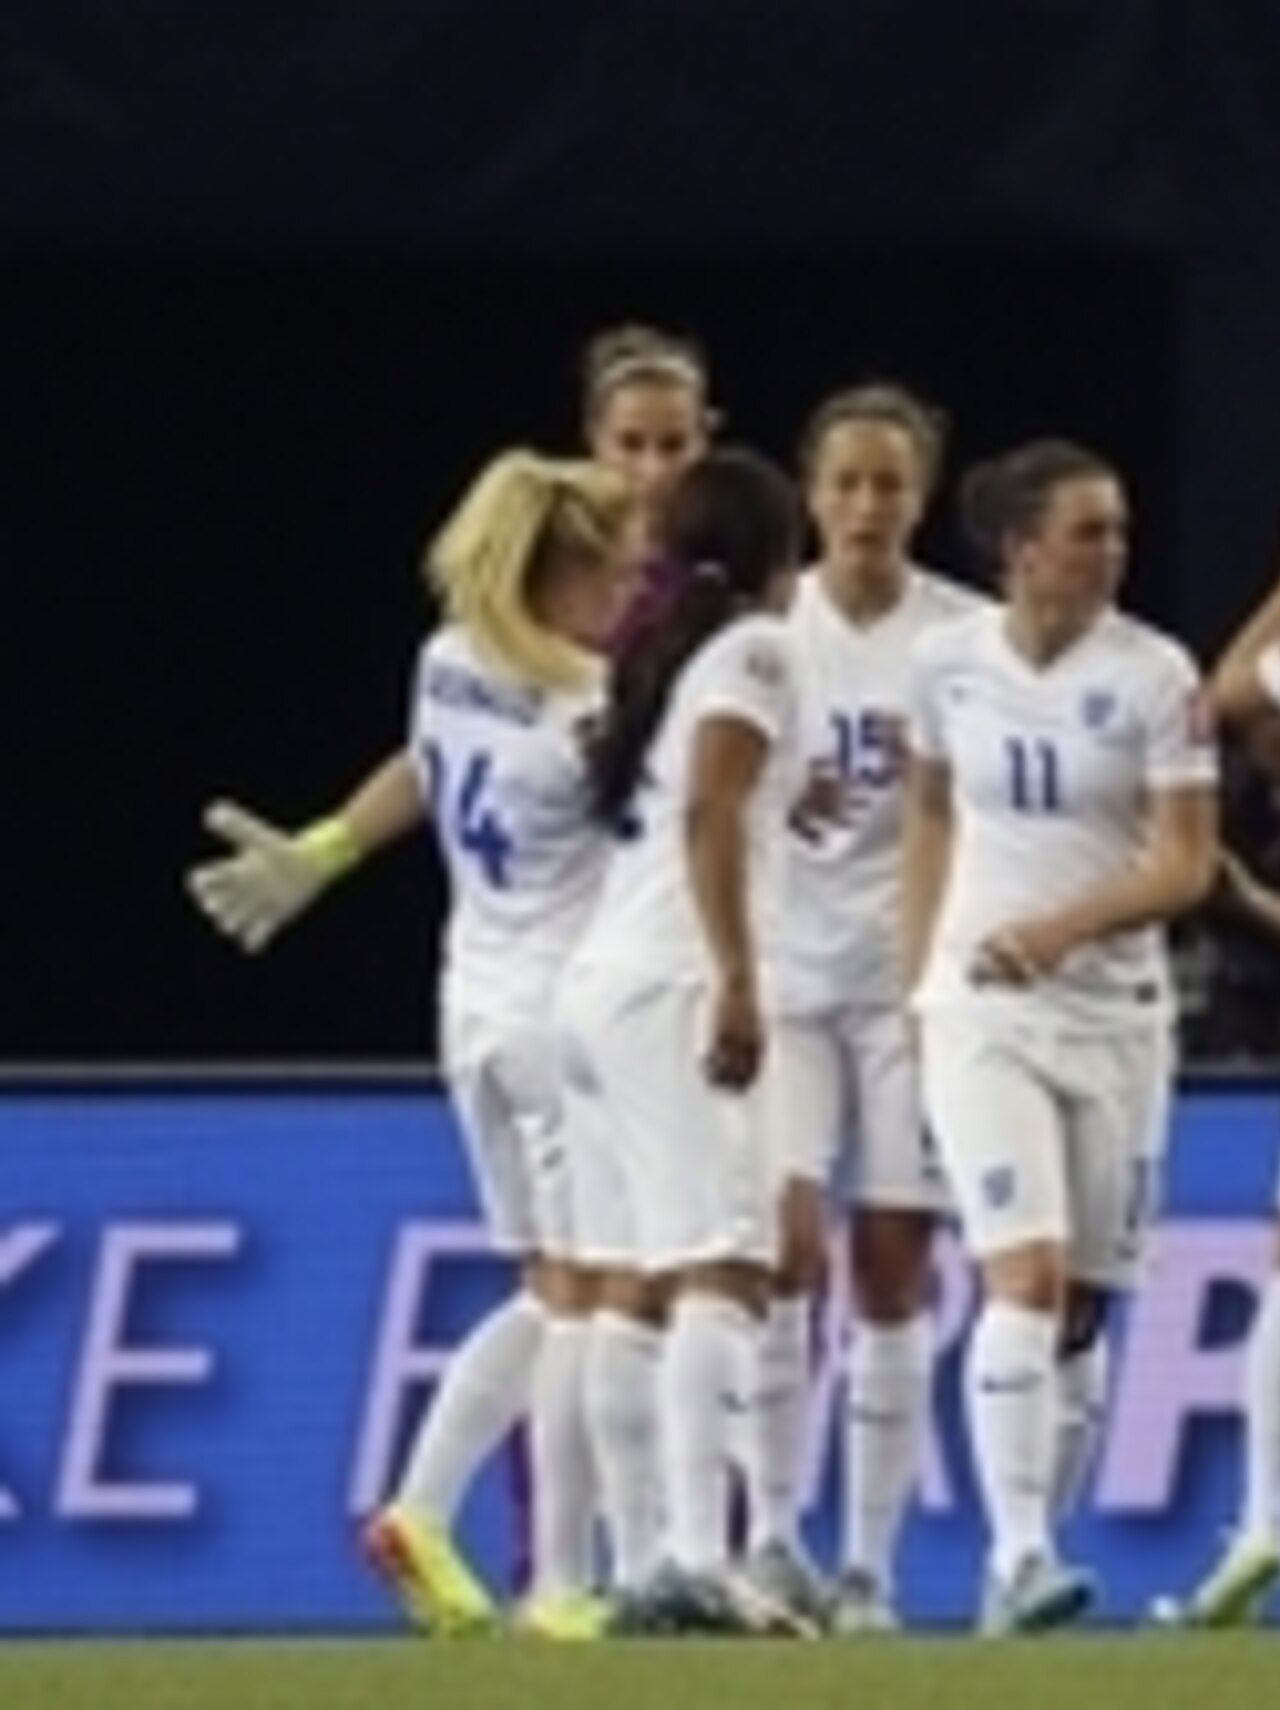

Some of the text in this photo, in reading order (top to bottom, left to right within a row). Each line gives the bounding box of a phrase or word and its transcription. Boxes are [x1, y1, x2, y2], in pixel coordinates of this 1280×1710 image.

[833, 711, 895, 788] 15
[1003, 736, 1061, 813] 11
[423, 737, 513, 888] 14
[347, 1219, 975, 1516] FR
